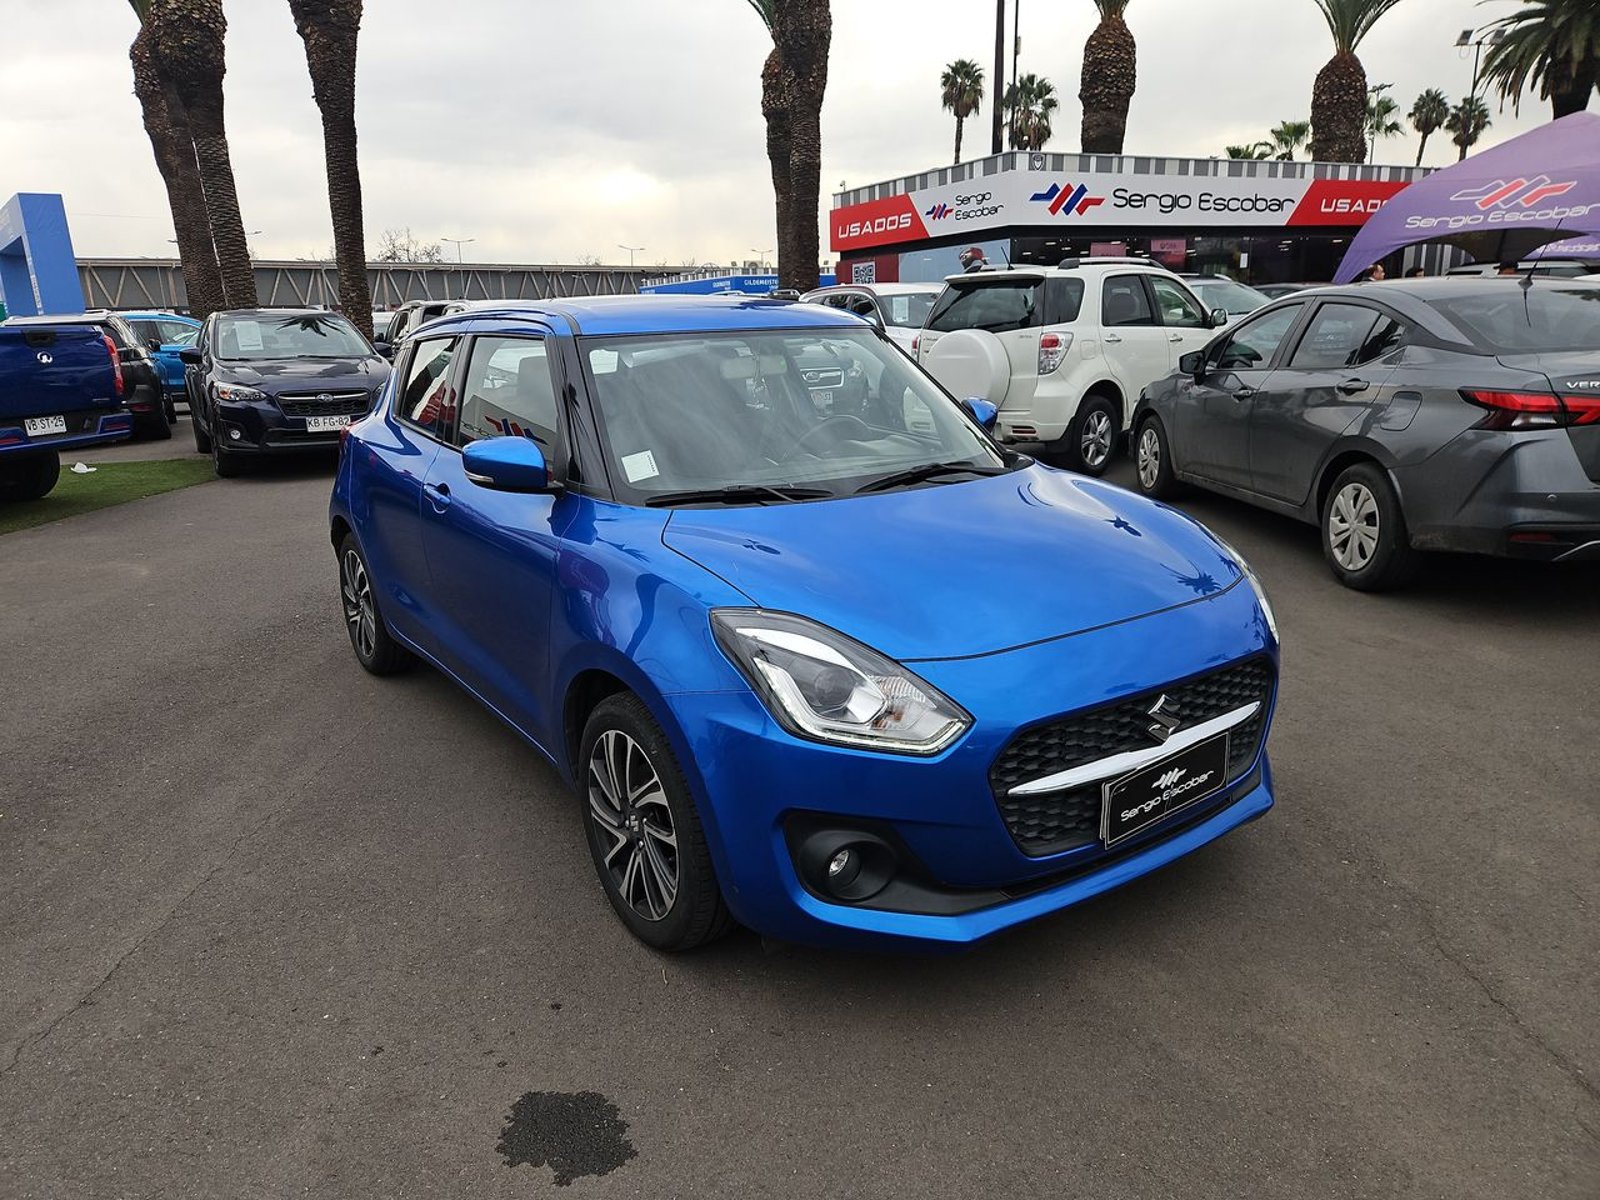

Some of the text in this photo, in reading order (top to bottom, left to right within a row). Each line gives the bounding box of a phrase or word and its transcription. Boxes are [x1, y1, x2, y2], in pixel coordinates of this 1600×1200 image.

[954, 204, 1005, 221] Escobar
[1112, 188, 1296, 214] Sergio Escobar
[1320, 198, 1389, 213] USAD
[837, 212, 913, 239] USADOS
[1404, 203, 1600, 229] Sergio Escobar
[1162, 770, 1215, 801] Escobar
